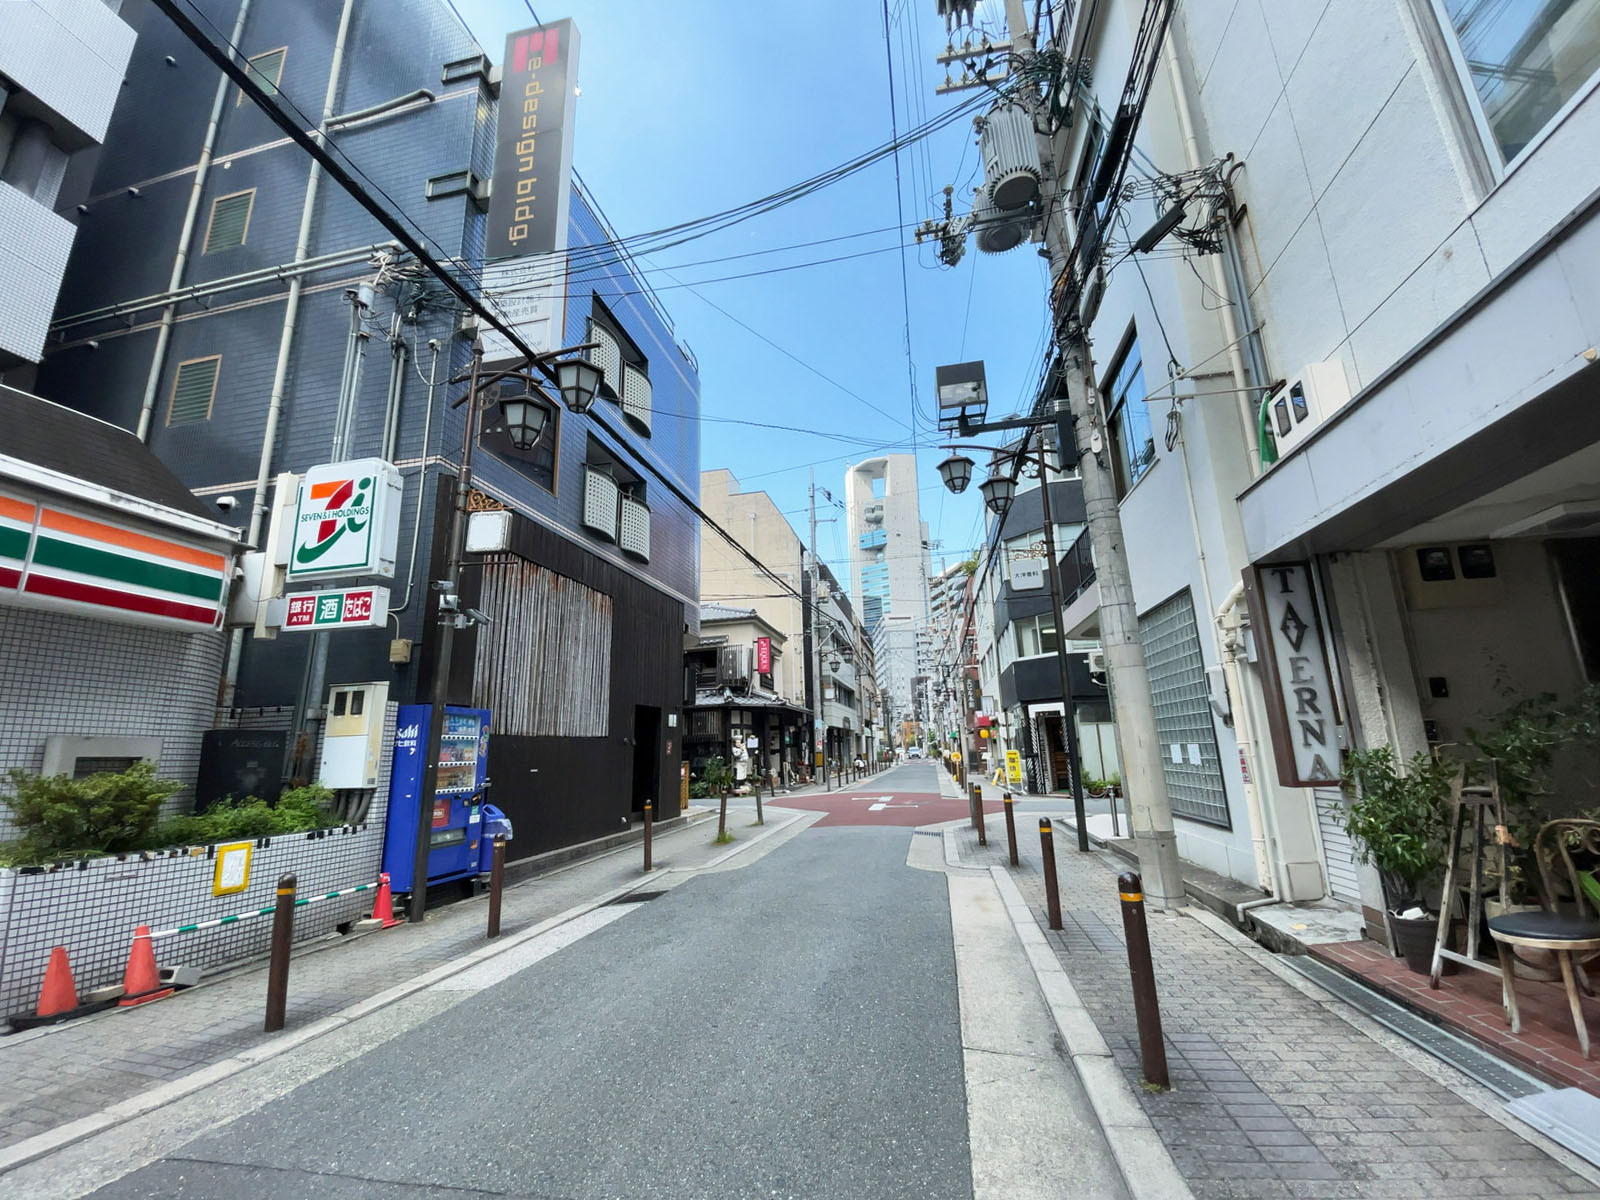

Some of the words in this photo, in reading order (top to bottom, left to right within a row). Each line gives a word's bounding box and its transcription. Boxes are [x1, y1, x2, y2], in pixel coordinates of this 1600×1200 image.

[515, 56, 544, 173] e-design
[508, 177, 537, 247] bldg.
[331, 506, 370, 518] HOLDINGS
[290, 599, 314, 613] 銀行
[320, 598, 340, 620] 酒
[343, 596, 371, 618] たばこ
[291, 614, 310, 623] ATM
[1271, 567, 1335, 781] TAVERNA
[396, 724, 419, 739] sahi
